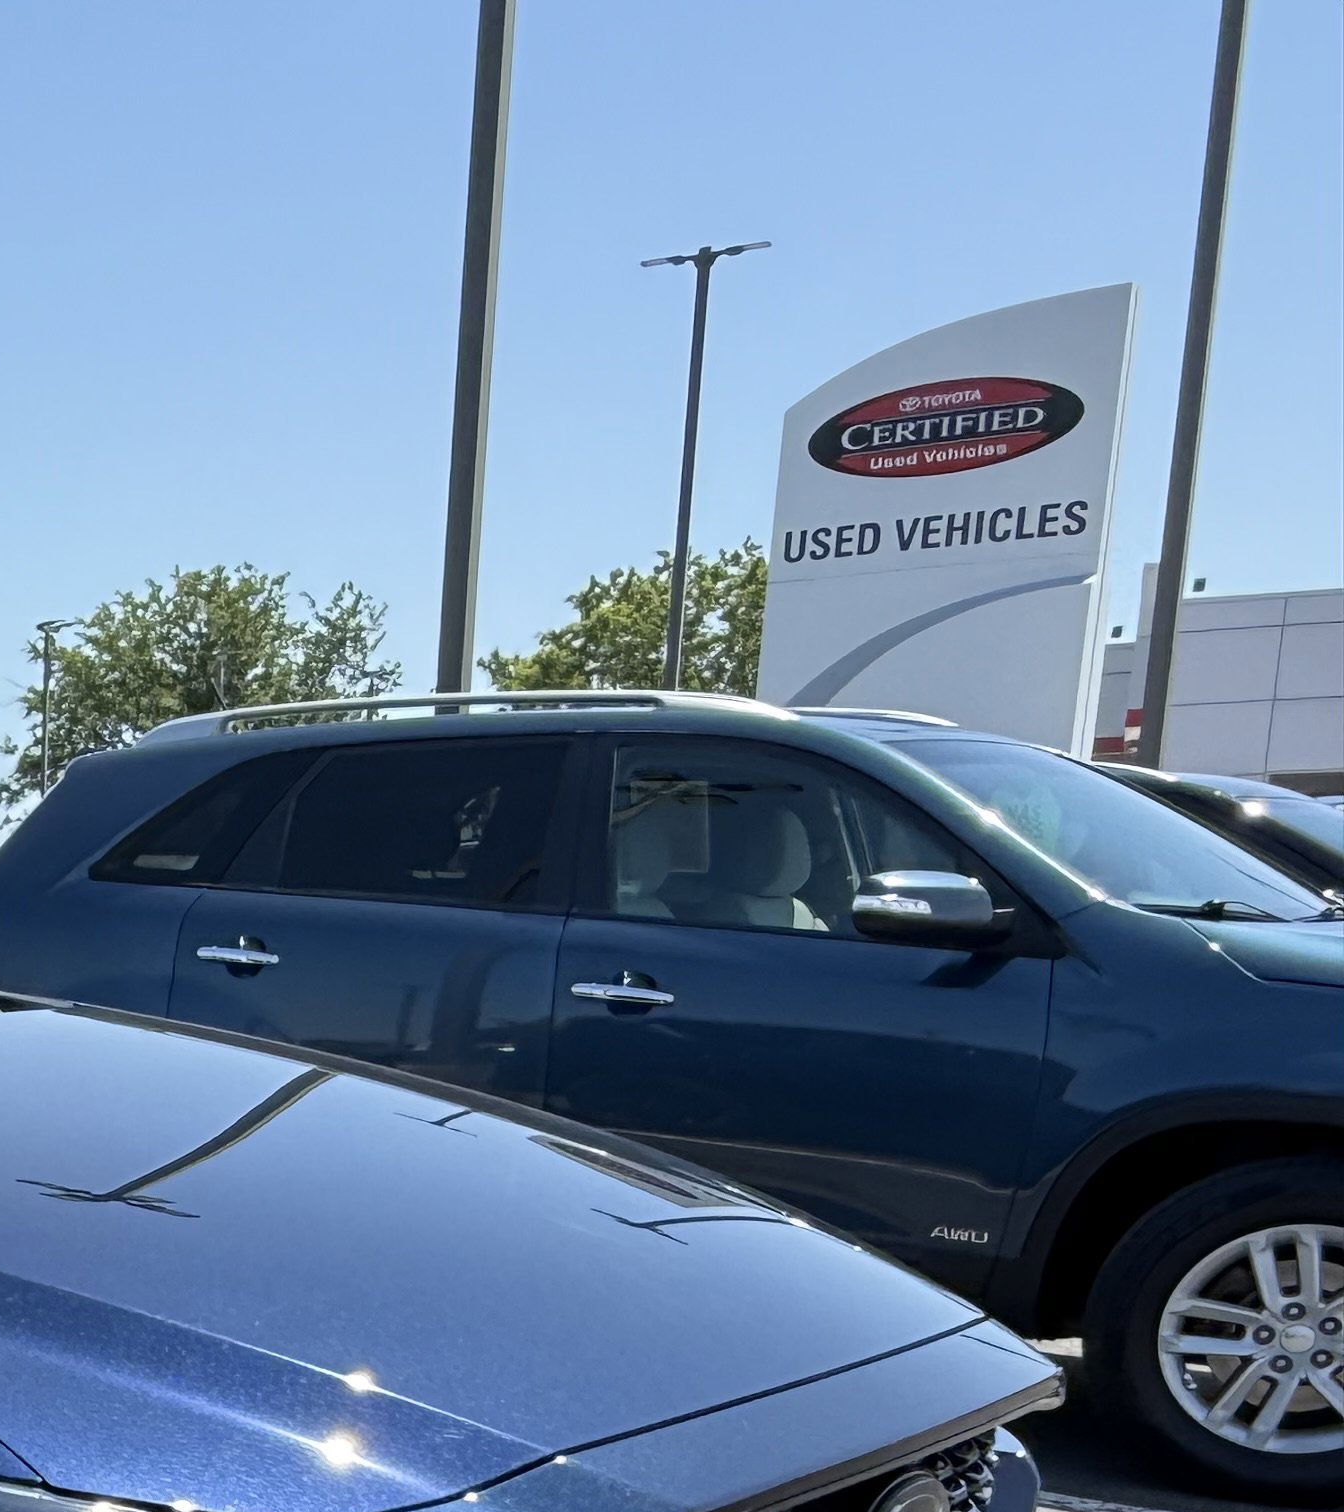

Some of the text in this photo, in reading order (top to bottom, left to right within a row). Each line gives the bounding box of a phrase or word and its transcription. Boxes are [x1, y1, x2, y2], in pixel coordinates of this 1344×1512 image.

[921, 388, 982, 408] TOYOTA
[840, 405, 1045, 451] CERTIFIED
[869, 443, 1009, 471] Used Vehicles
[783, 500, 1089, 564] USED VEHICLES
